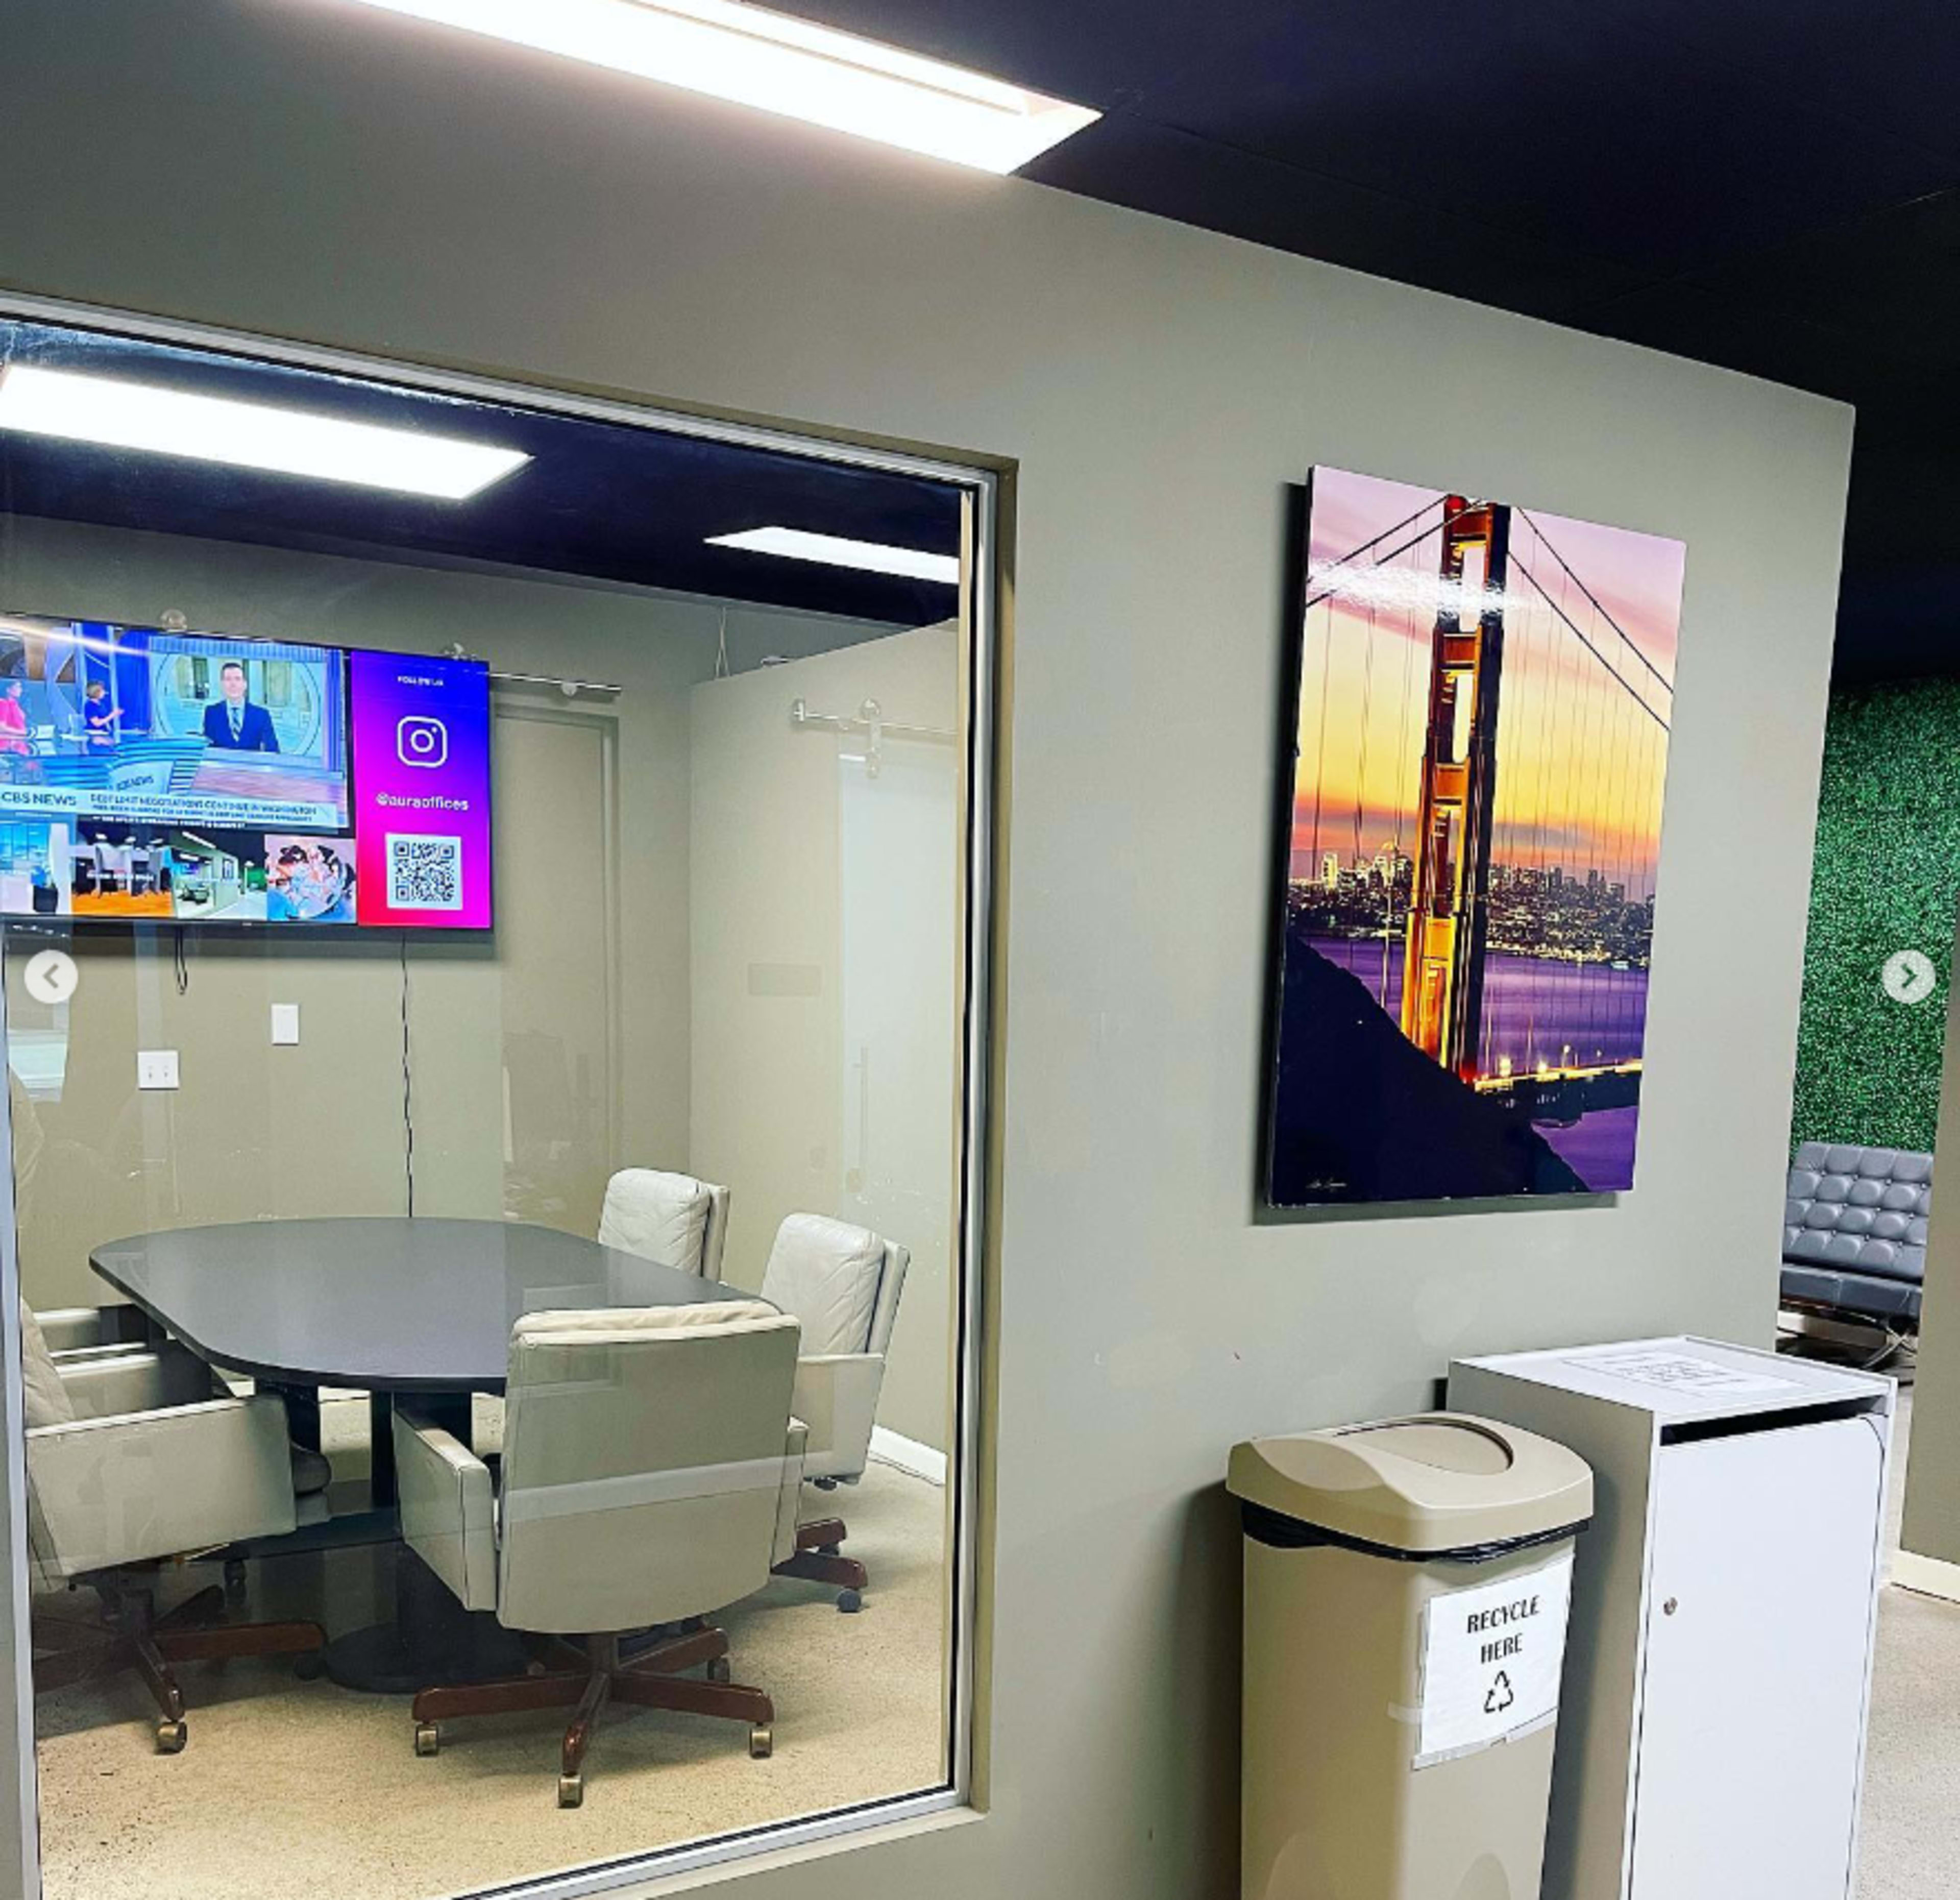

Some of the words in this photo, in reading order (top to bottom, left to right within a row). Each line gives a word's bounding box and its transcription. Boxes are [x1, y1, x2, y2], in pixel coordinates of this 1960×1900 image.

[2, 792, 31, 804] CBS
[33, 793, 76, 806] NEWS
[376, 792, 469, 811] @auraoffices
[1467, 1595, 1540, 1633] RECYCLE
[1481, 1633, 1523, 1664] HERE
